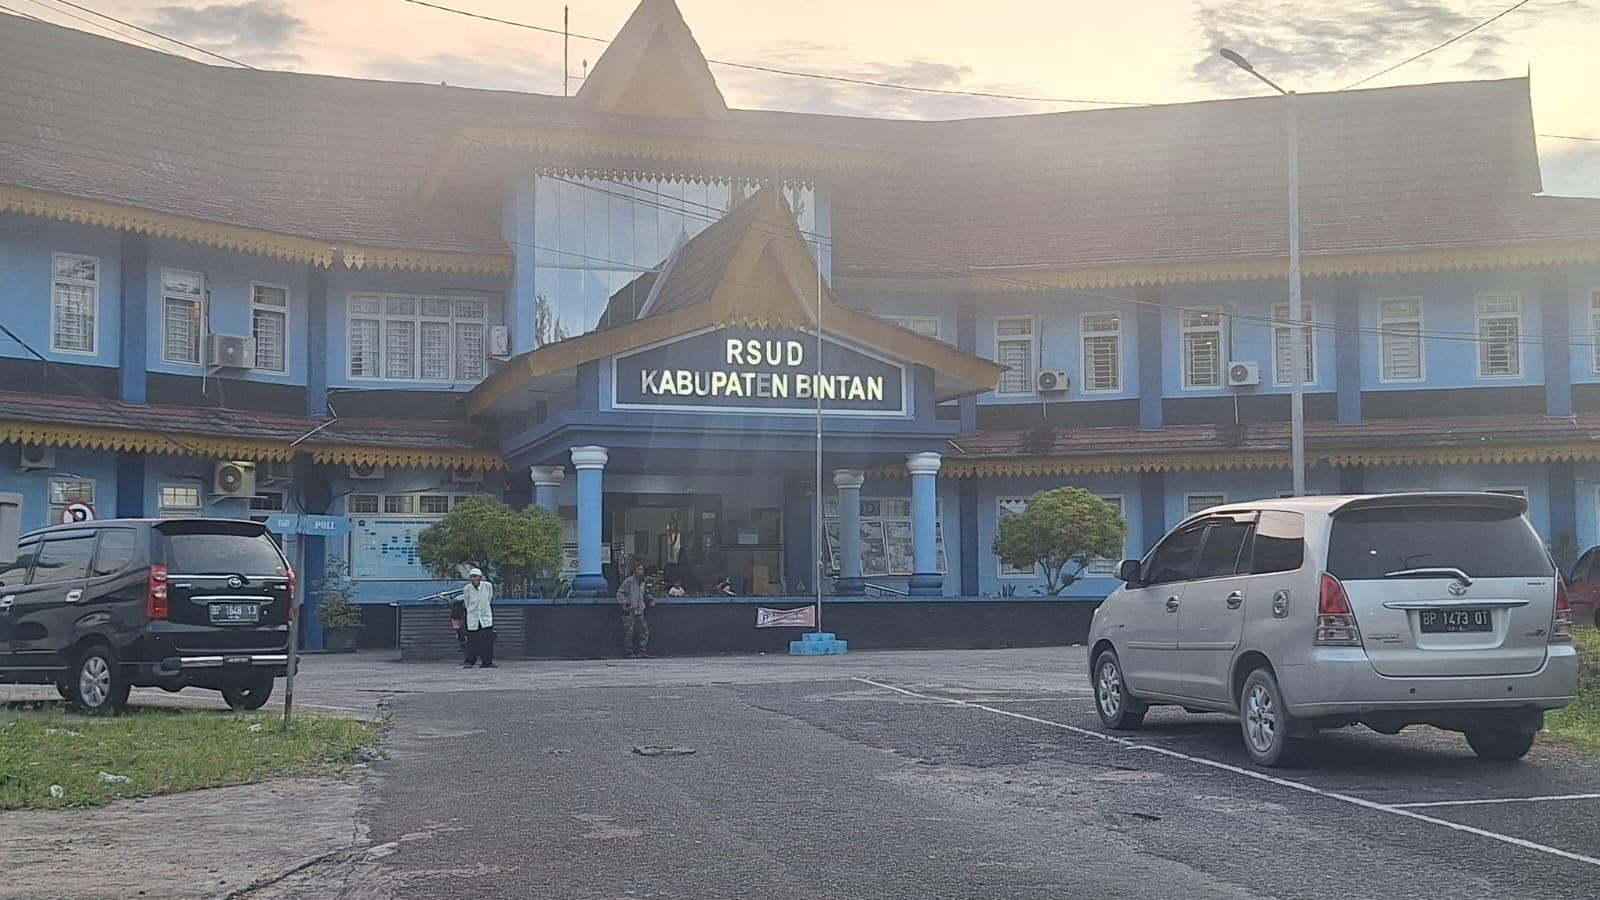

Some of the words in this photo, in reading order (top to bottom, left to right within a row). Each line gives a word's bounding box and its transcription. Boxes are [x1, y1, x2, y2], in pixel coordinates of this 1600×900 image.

[726, 339, 803, 366] RSUD
[641, 369, 788, 398] KABUPATEN
[795, 373, 883, 401] BINTAN
[1423, 612, 1437, 625] BP
[1443, 612, 1468, 625] 1473
